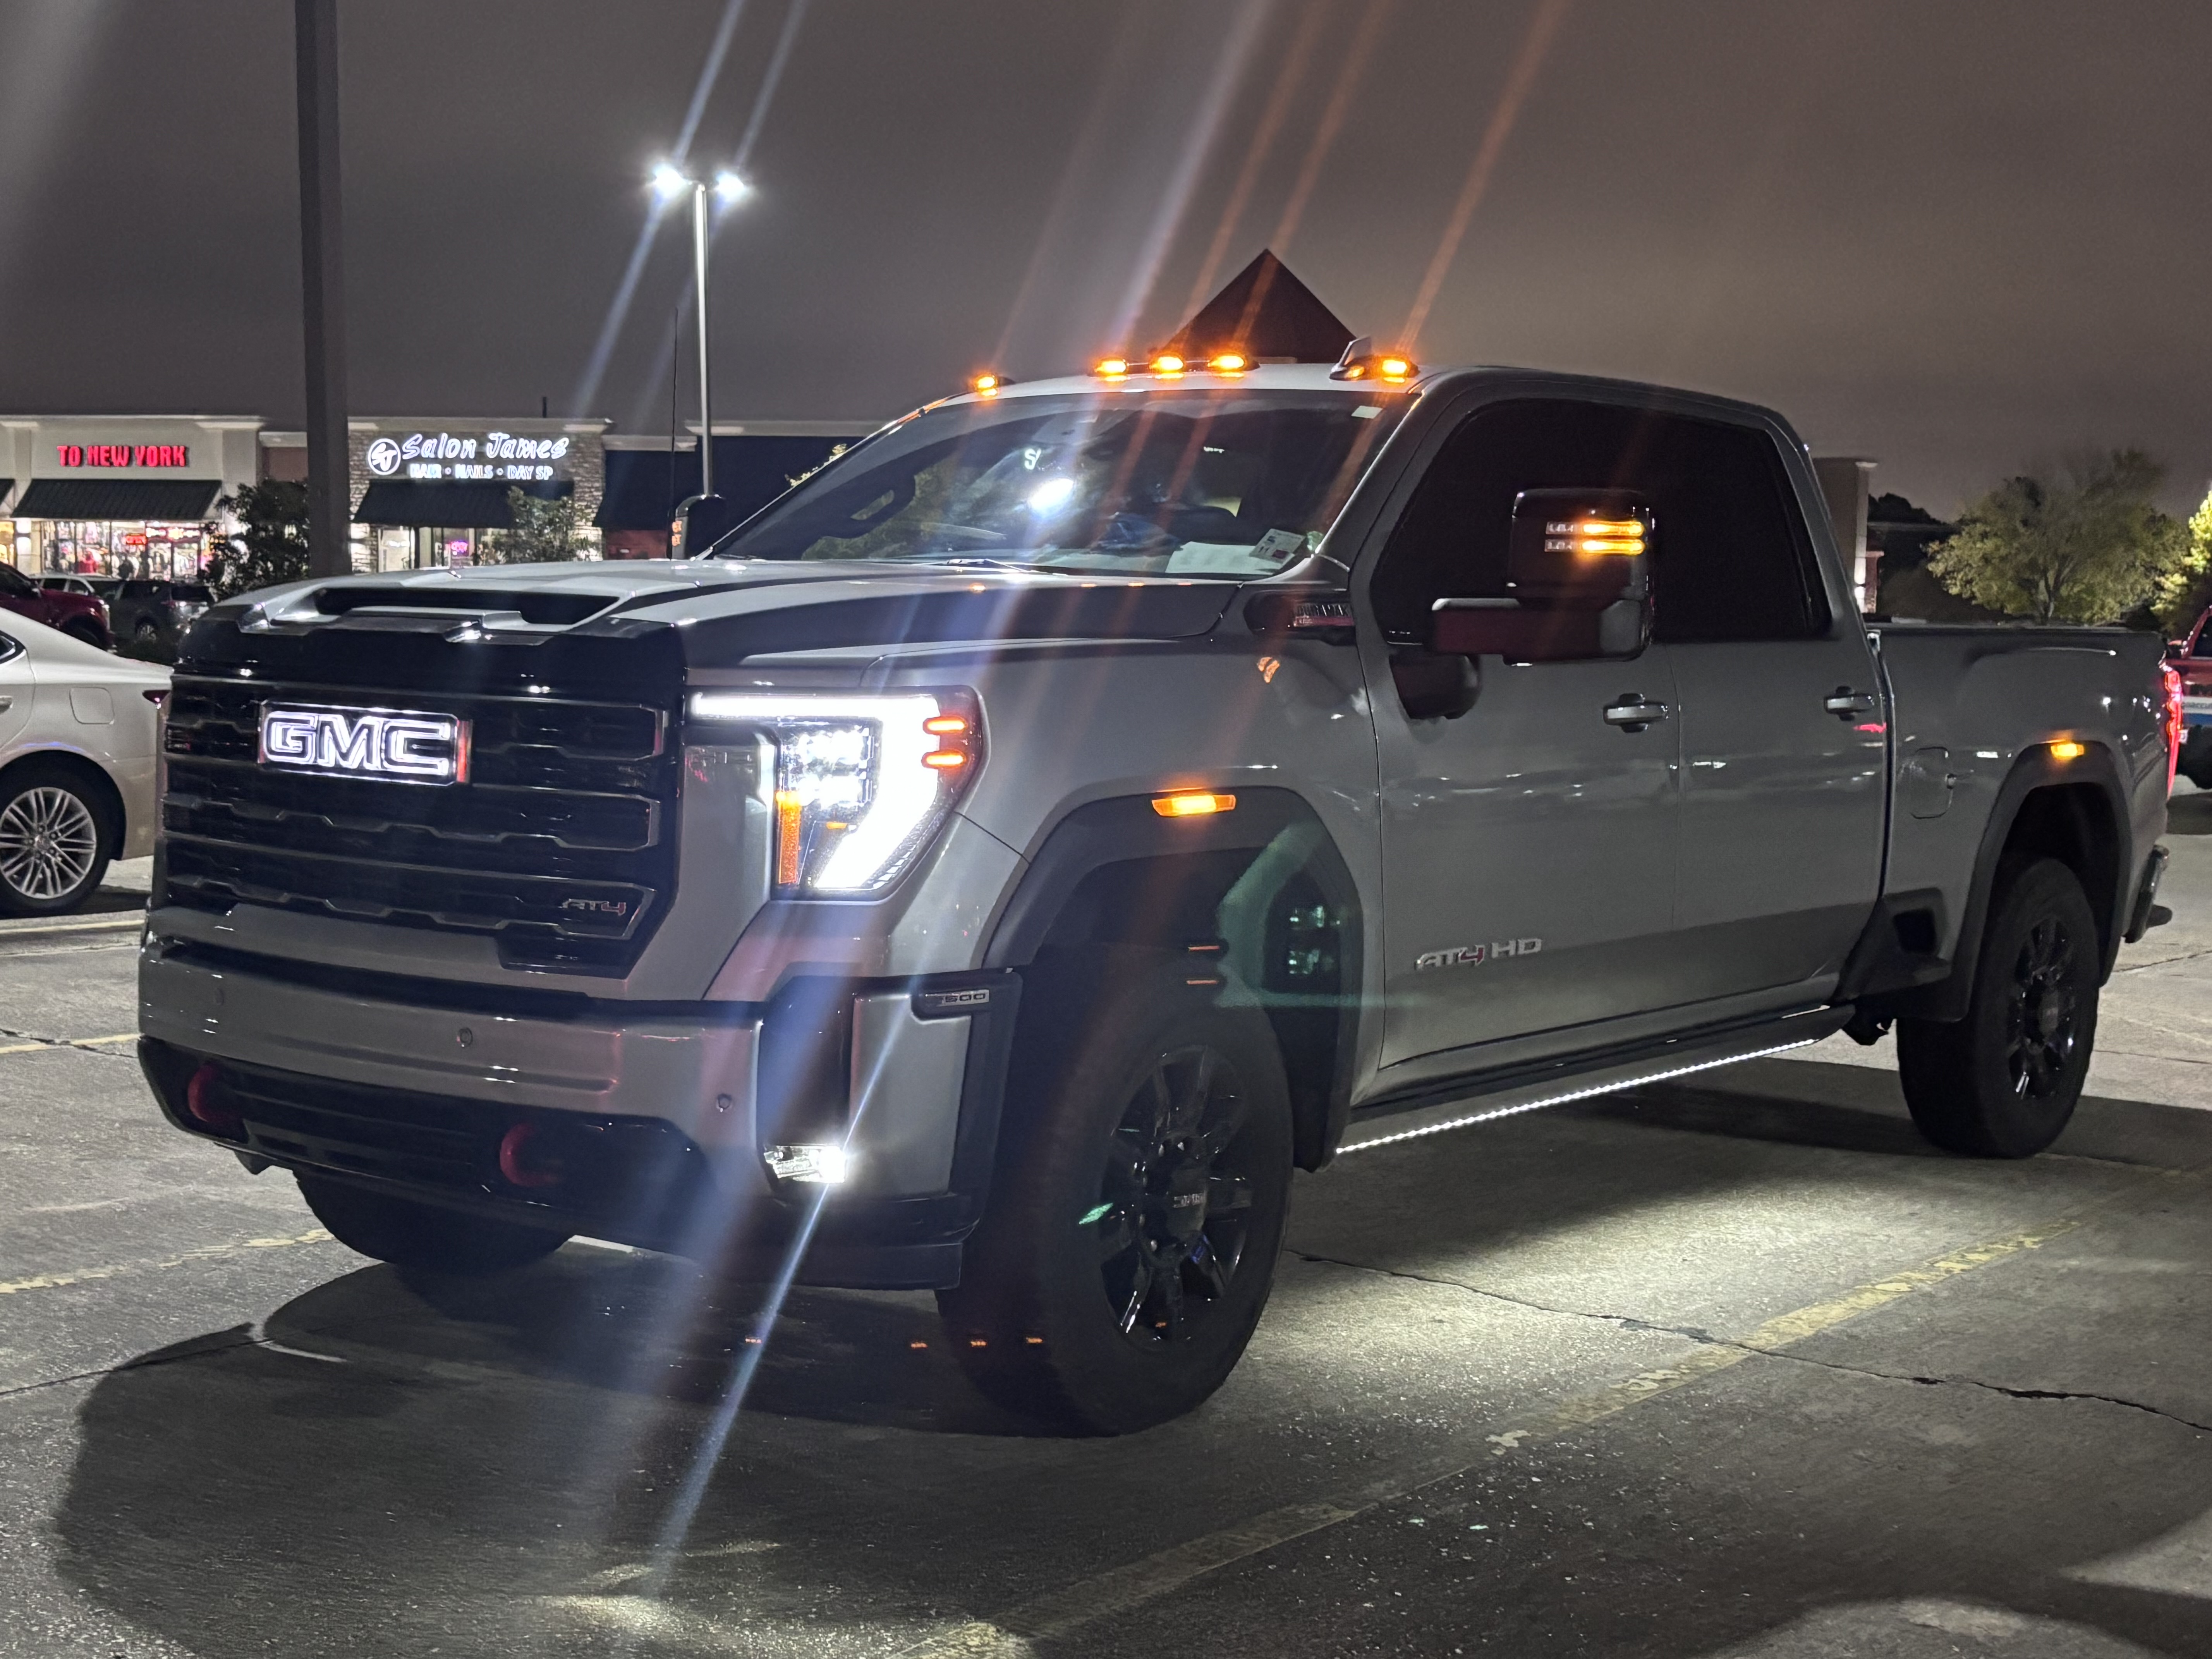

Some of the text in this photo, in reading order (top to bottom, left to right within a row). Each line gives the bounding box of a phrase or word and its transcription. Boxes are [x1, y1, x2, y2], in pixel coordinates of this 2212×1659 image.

[57, 445, 185, 467] TO NEW YORK
[402, 432, 569, 460] Salon James
[455, 464, 494, 479] NAILS
[507, 465, 534, 480] DAY
[263, 711, 451, 775] GMC
[562, 898, 626, 916] AT4
[1415, 938, 1542, 970] AT4 HD
